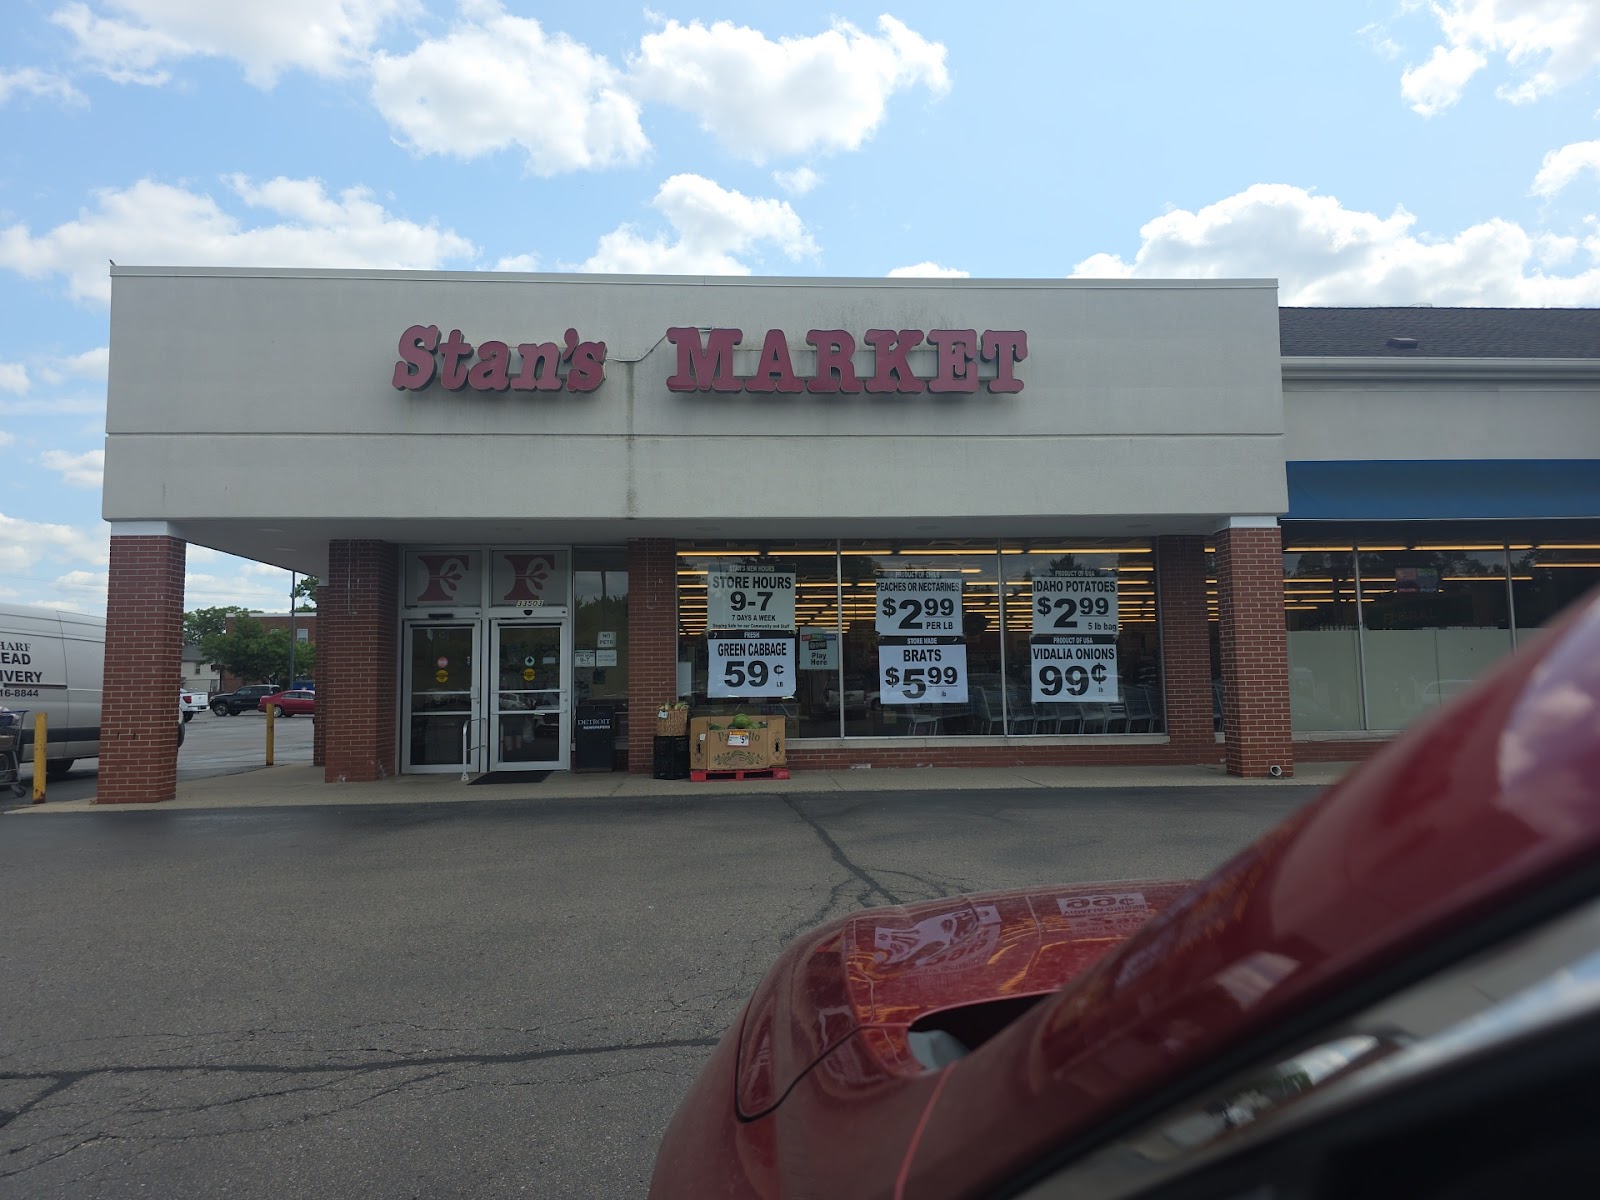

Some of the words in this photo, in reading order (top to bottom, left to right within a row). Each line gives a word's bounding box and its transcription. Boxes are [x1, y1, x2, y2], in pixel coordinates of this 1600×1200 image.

[391, 324, 607, 393] Stan's
[665, 326, 1028, 395] MARKET
[713, 576, 750, 589] STORE
[753, 576, 792, 590] HOURS
[876, 582, 907, 592] PEACHES
[907, 582, 918, 592] OR
[919, 582, 960, 592] NECTARINES
[1033, 581, 1063, 592] IDAHO
[1066, 581, 1116, 593] POTATOES
[730, 591, 773, 612] 9-7
[926, 622, 941, 630] PER
[943, 622, 953, 630] LB
[1087, 622, 1093, 630] 5
[1094, 622, 1102, 630] lb
[1103, 622, 1117, 632] bag
[744, 631, 760, 639] FRESH
[906, 637, 923, 645] STORE
[924, 637, 938, 645] MADE
[718, 643, 746, 656] GREEN
[748, 642, 787, 656] CABBAGE
[1075, 648, 1115, 660] ONIONS
[0, 652, 31, 665] EAD
[811, 652, 827, 660] Play
[903, 649, 942, 662] BRATS
